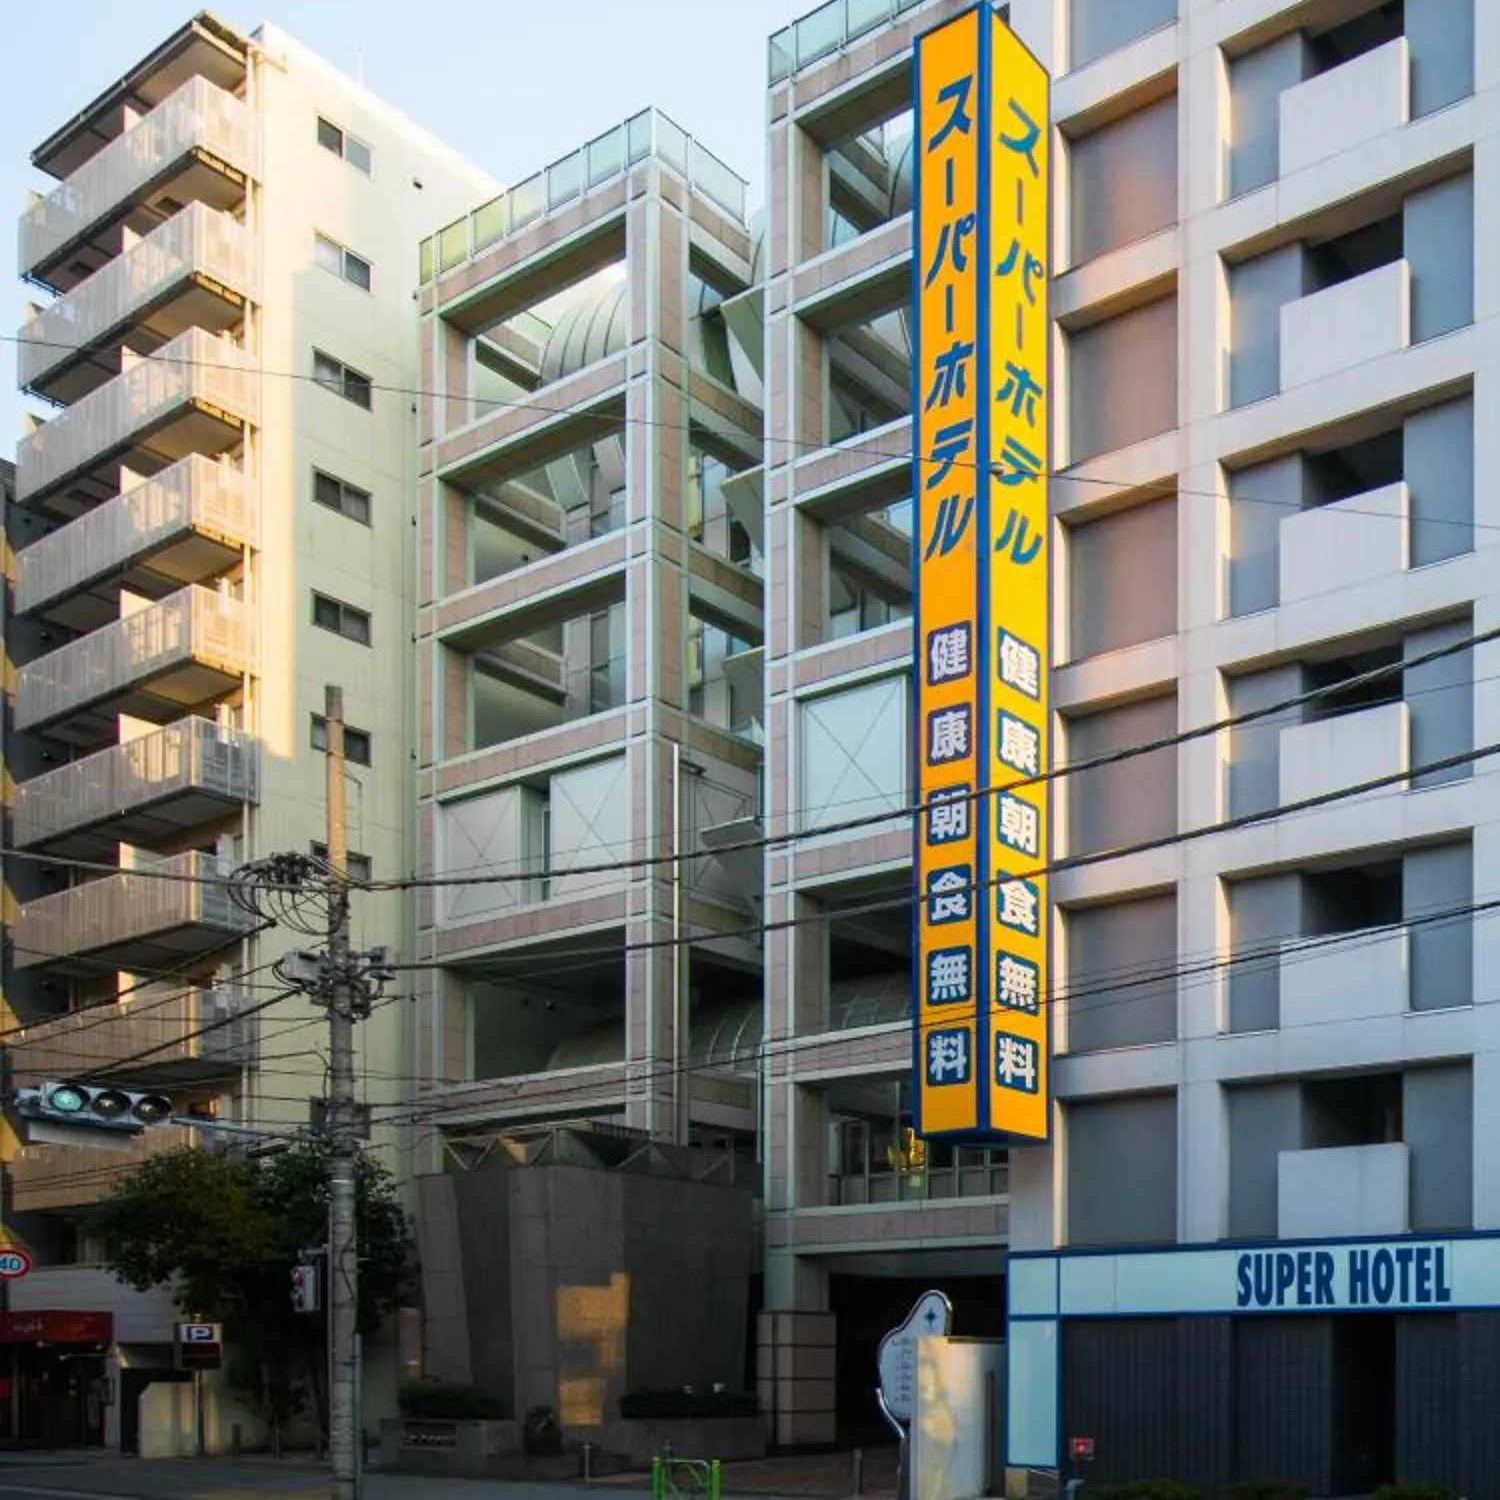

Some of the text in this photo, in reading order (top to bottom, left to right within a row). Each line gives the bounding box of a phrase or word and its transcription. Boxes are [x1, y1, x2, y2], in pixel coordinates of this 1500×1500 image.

[925, 73, 975, 563] スーパーホテル
[995, 96, 1044, 566] スーパーホテル
[927, 622, 969, 1085] 健康朝食無料
[997, 629, 1040, 1094] 健康朝食無料
[1237, 1247, 1451, 1306] SUPER HOTEL
